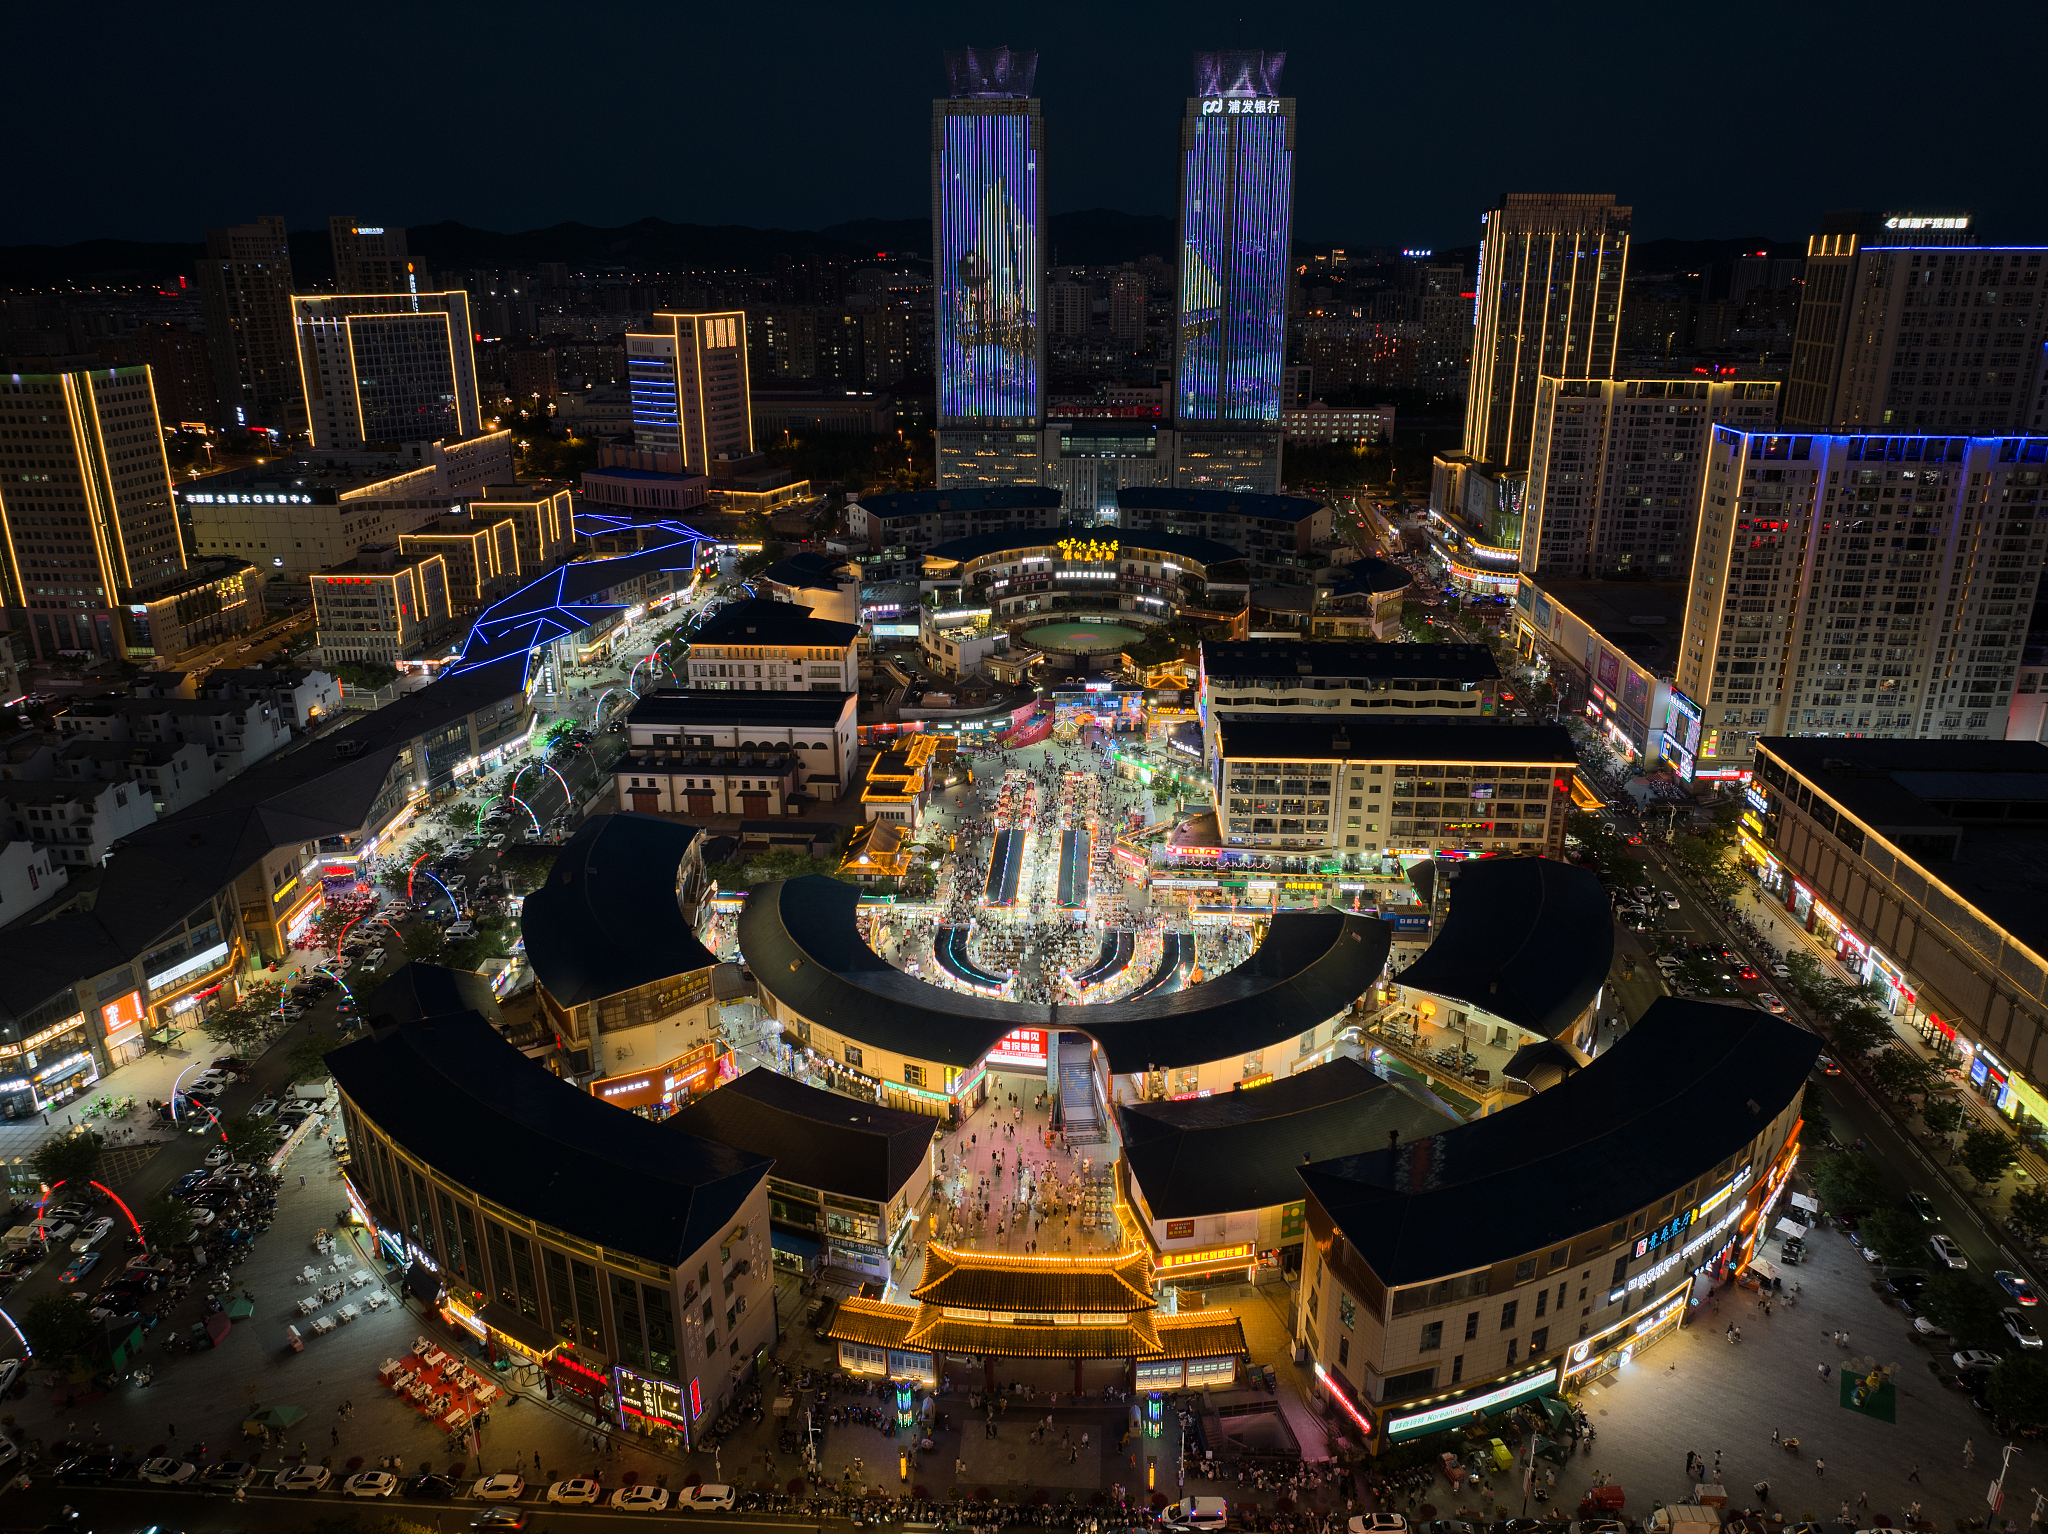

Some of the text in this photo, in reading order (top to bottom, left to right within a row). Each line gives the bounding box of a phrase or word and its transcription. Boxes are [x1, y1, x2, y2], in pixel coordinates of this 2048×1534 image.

[1227, 99, 1280, 114] 浦发银行
[1648, 1210, 1691, 1247] 音乐餐厅
[1427, 1403, 1469, 1421] Koreanmart
